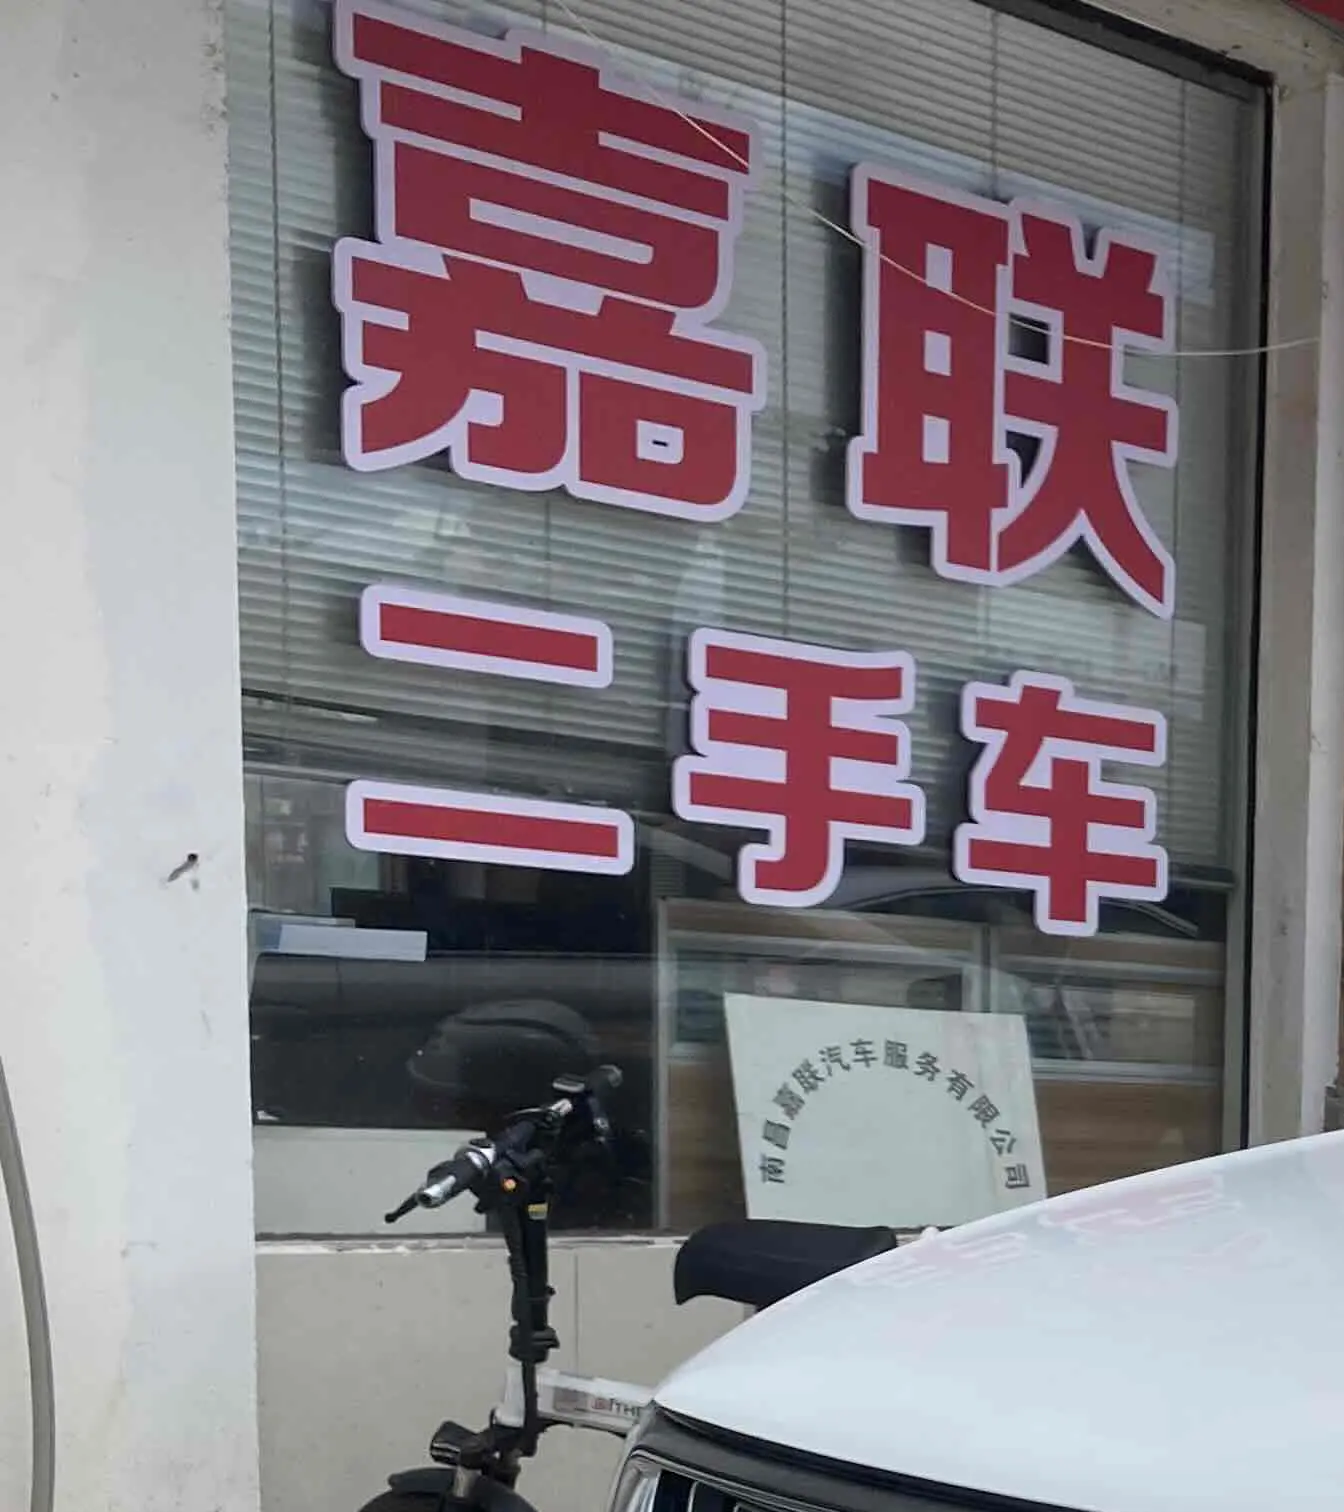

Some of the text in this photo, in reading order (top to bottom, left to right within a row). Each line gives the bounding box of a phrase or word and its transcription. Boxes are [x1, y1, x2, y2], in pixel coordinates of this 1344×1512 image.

[333, 0, 1178, 619] 嘉联
[345, 585, 1168, 936] 二手车
[759, 1038, 1031, 1190] 南昌嘉联汽车服务有限公司
